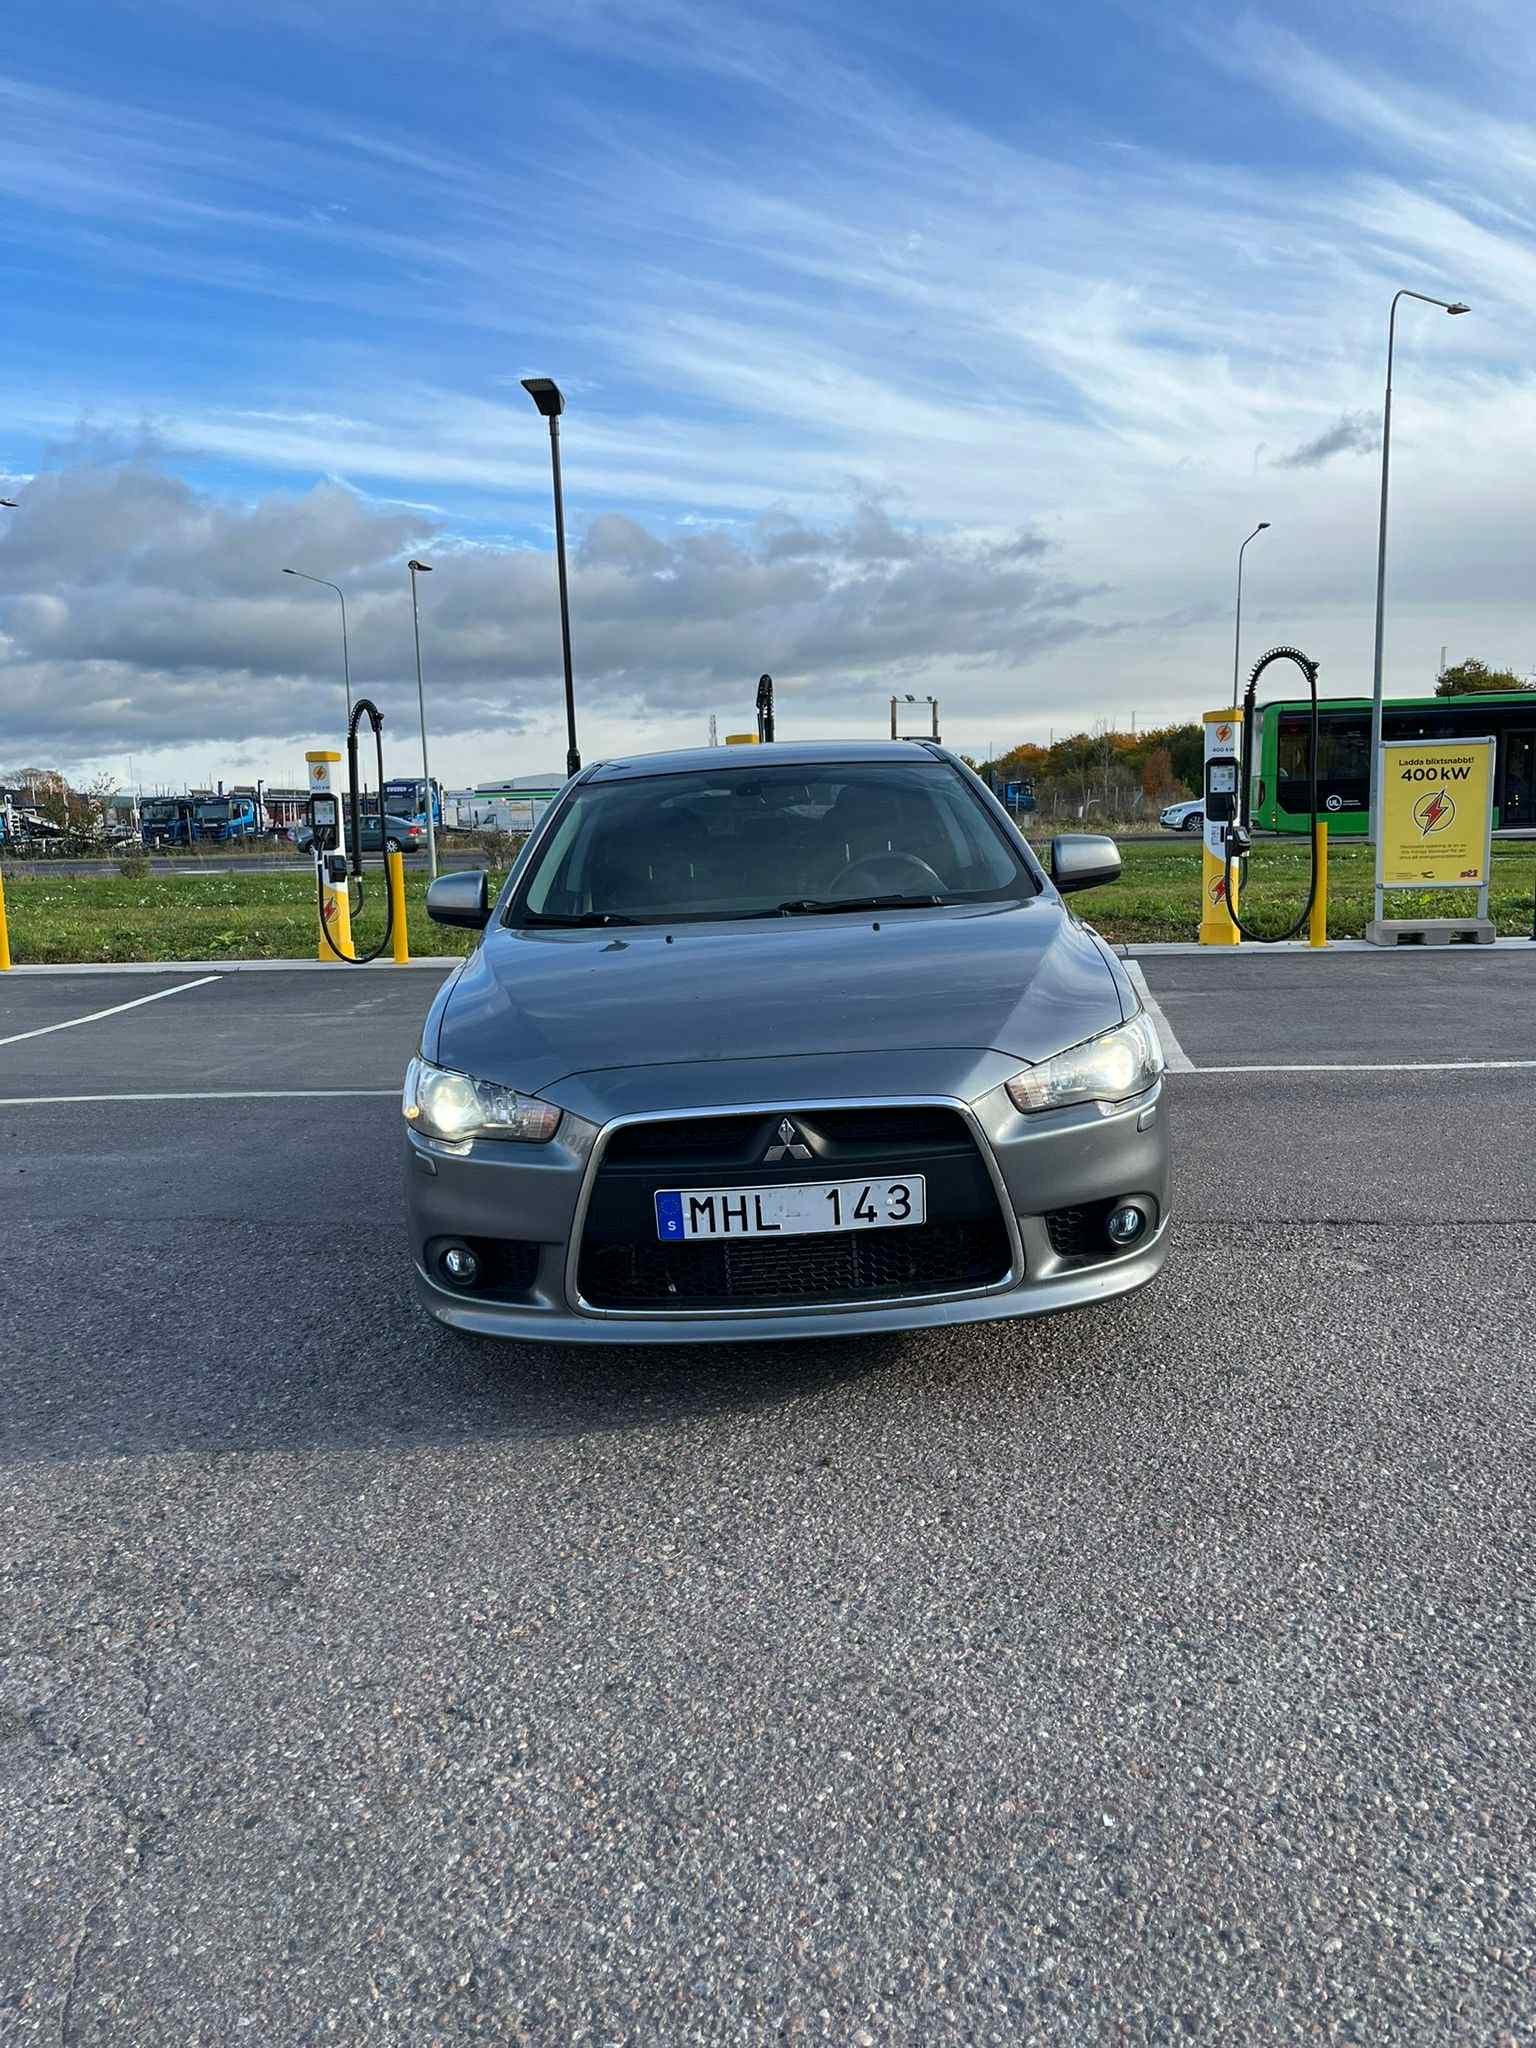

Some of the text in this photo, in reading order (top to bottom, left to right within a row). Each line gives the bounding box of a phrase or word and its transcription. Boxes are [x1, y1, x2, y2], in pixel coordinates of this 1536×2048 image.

[1426, 757, 1474, 765] blixtsnabbt!
[1401, 766, 1471, 782] 400 kW
[689, 1184, 912, 1233] MHL 143
[667, 1220, 677, 1231] S
